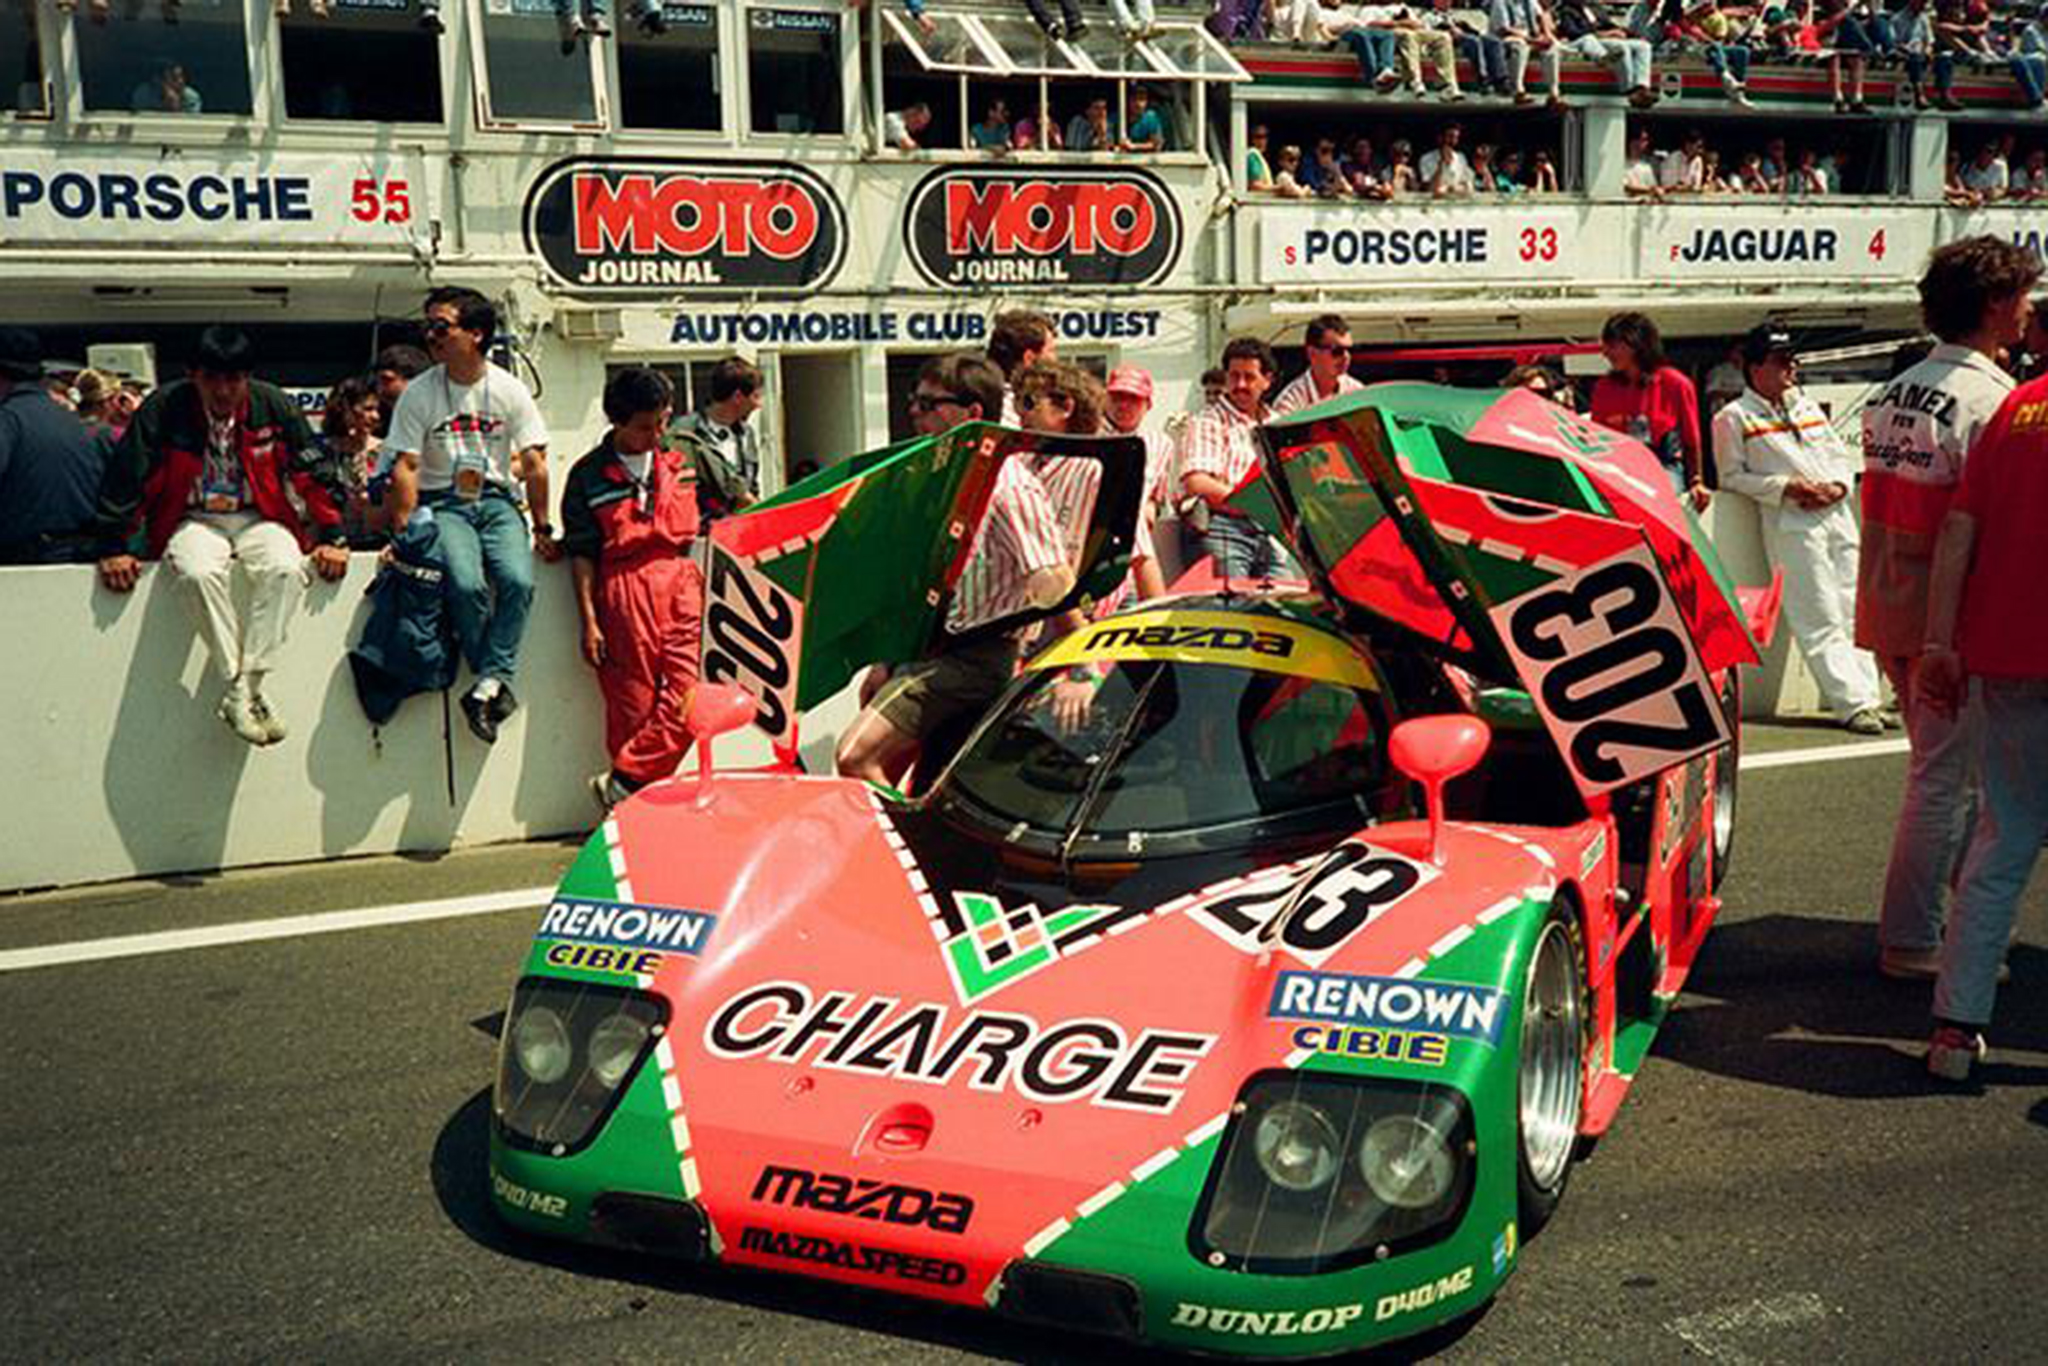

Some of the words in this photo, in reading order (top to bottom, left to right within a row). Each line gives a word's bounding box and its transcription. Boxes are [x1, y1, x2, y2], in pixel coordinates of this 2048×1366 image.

[2, 172, 313, 221] PORSCHE
[351, 178, 411, 222] 55
[573, 173, 819, 259] MOTO
[946, 181, 1157, 256] MOTO
[1284, 245, 1297, 266] S
[1305, 229, 1487, 263] PORSCHE
[1519, 227, 1560, 262] 33
[1670, 245, 1680, 263] F
[1682, 229, 1837, 263] JAGUAR
[1867, 228, 1886, 261] 4
[579, 260, 721, 284] JOURNAL
[949, 258, 1070, 282] JOURNAL
[669, 313, 898, 343] AUTOMOBILE
[906, 313, 986, 340] CLUB
[1084, 625, 1295, 659] mazda
[1510, 561, 1722, 783] 203
[540, 902, 706, 949] RENOWN
[547, 944, 664, 976] CIBIE
[1278, 975, 1498, 1034] RENOWN
[707, 983, 1210, 1110] CHARGE
[1292, 1026, 1447, 1064] CIBIE
[751, 1164, 975, 1235] mazda
[1170, 1302, 1363, 1336] DUNLOP
